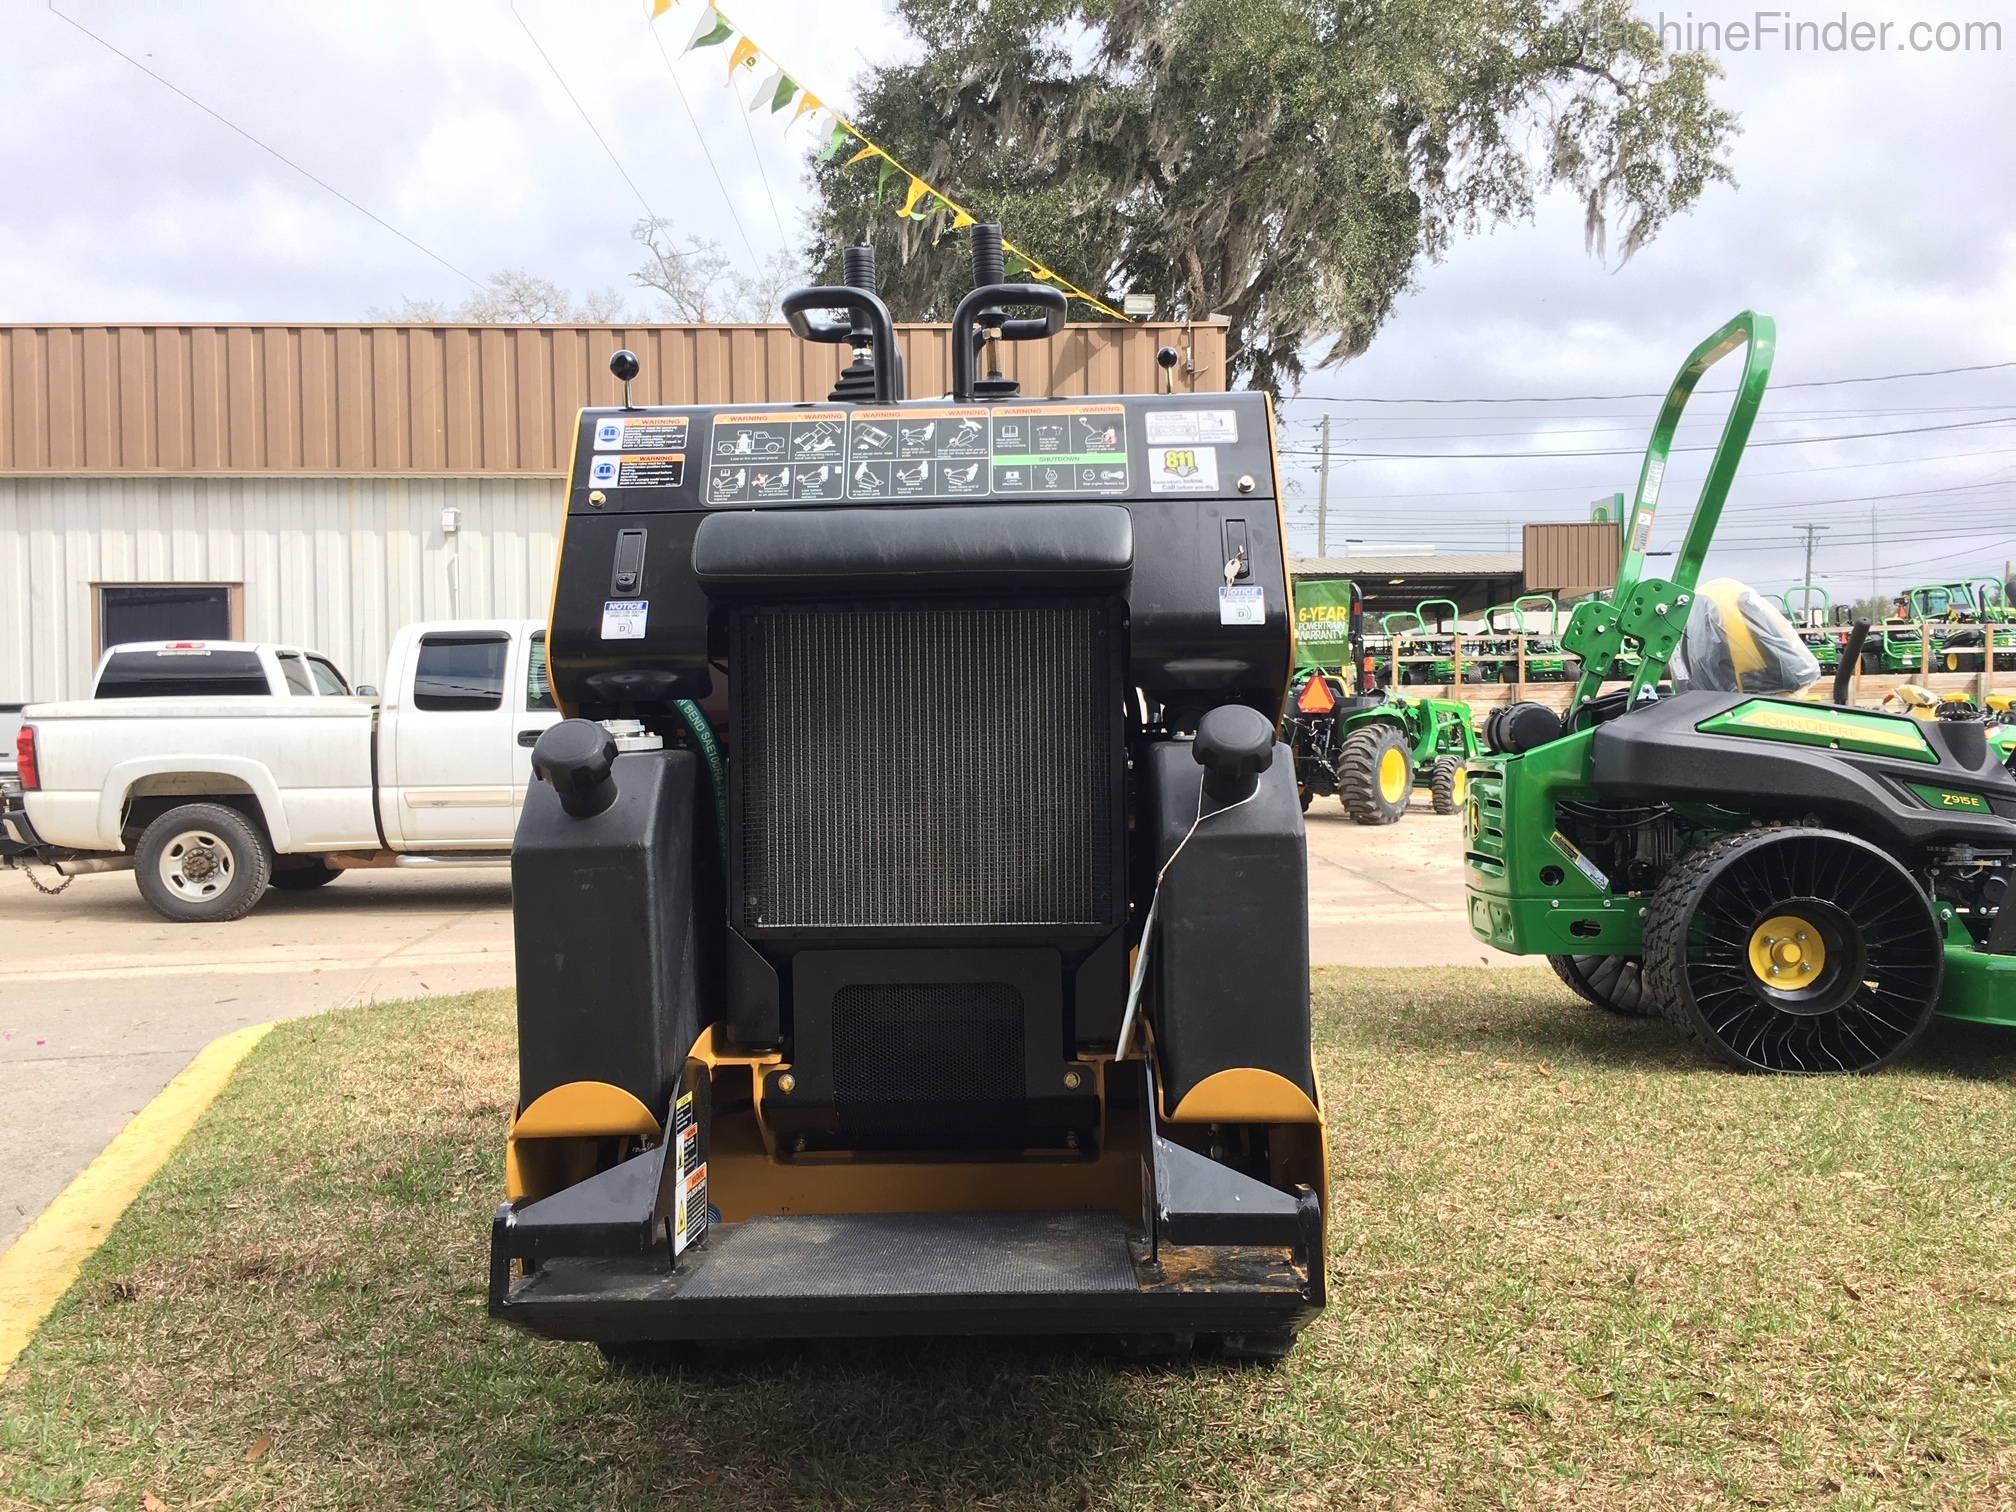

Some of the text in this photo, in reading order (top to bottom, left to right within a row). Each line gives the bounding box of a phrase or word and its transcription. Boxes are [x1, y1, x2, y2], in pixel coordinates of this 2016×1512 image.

[1164, 450, 1196, 469] 811
[1299, 606, 1347, 622] 6-YEAR
[1298, 621, 1346, 631] POWERTRAIN
[1299, 629, 1345, 641] WARRANTY
[683, 704, 706, 732] BEND
[1757, 713, 1861, 738] JOHN DEERE
[1941, 794, 1980, 807] Z915E
